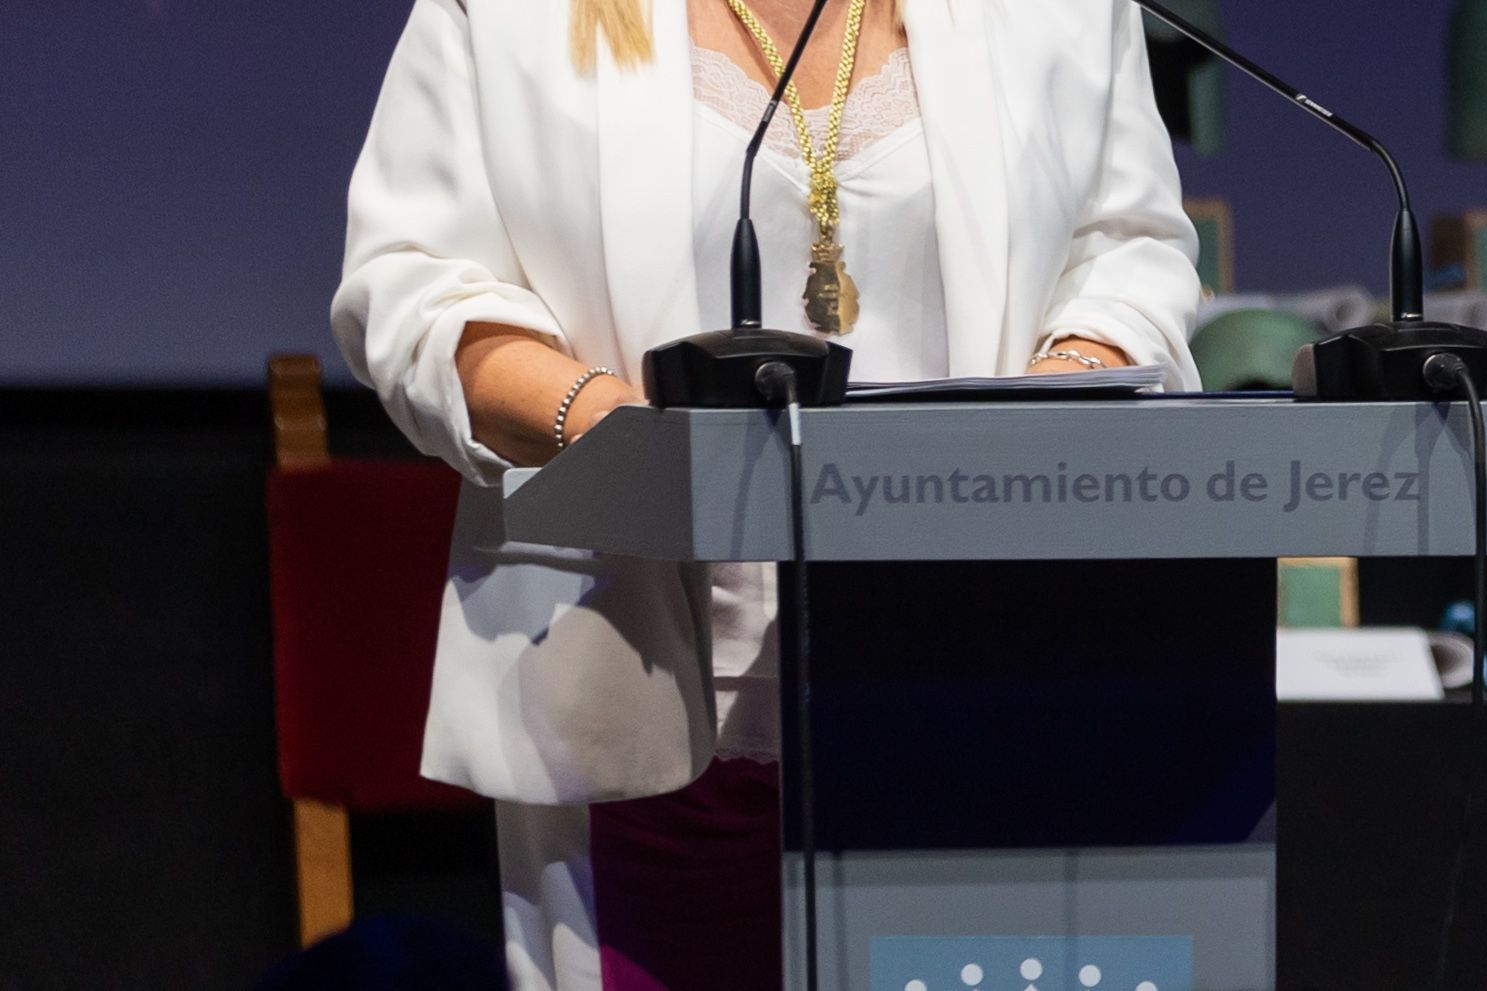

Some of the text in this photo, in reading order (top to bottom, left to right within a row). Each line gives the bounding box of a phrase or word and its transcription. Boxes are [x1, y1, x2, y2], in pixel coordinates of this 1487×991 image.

[811, 459, 1420, 517] Ayuntamiento de Jerez
